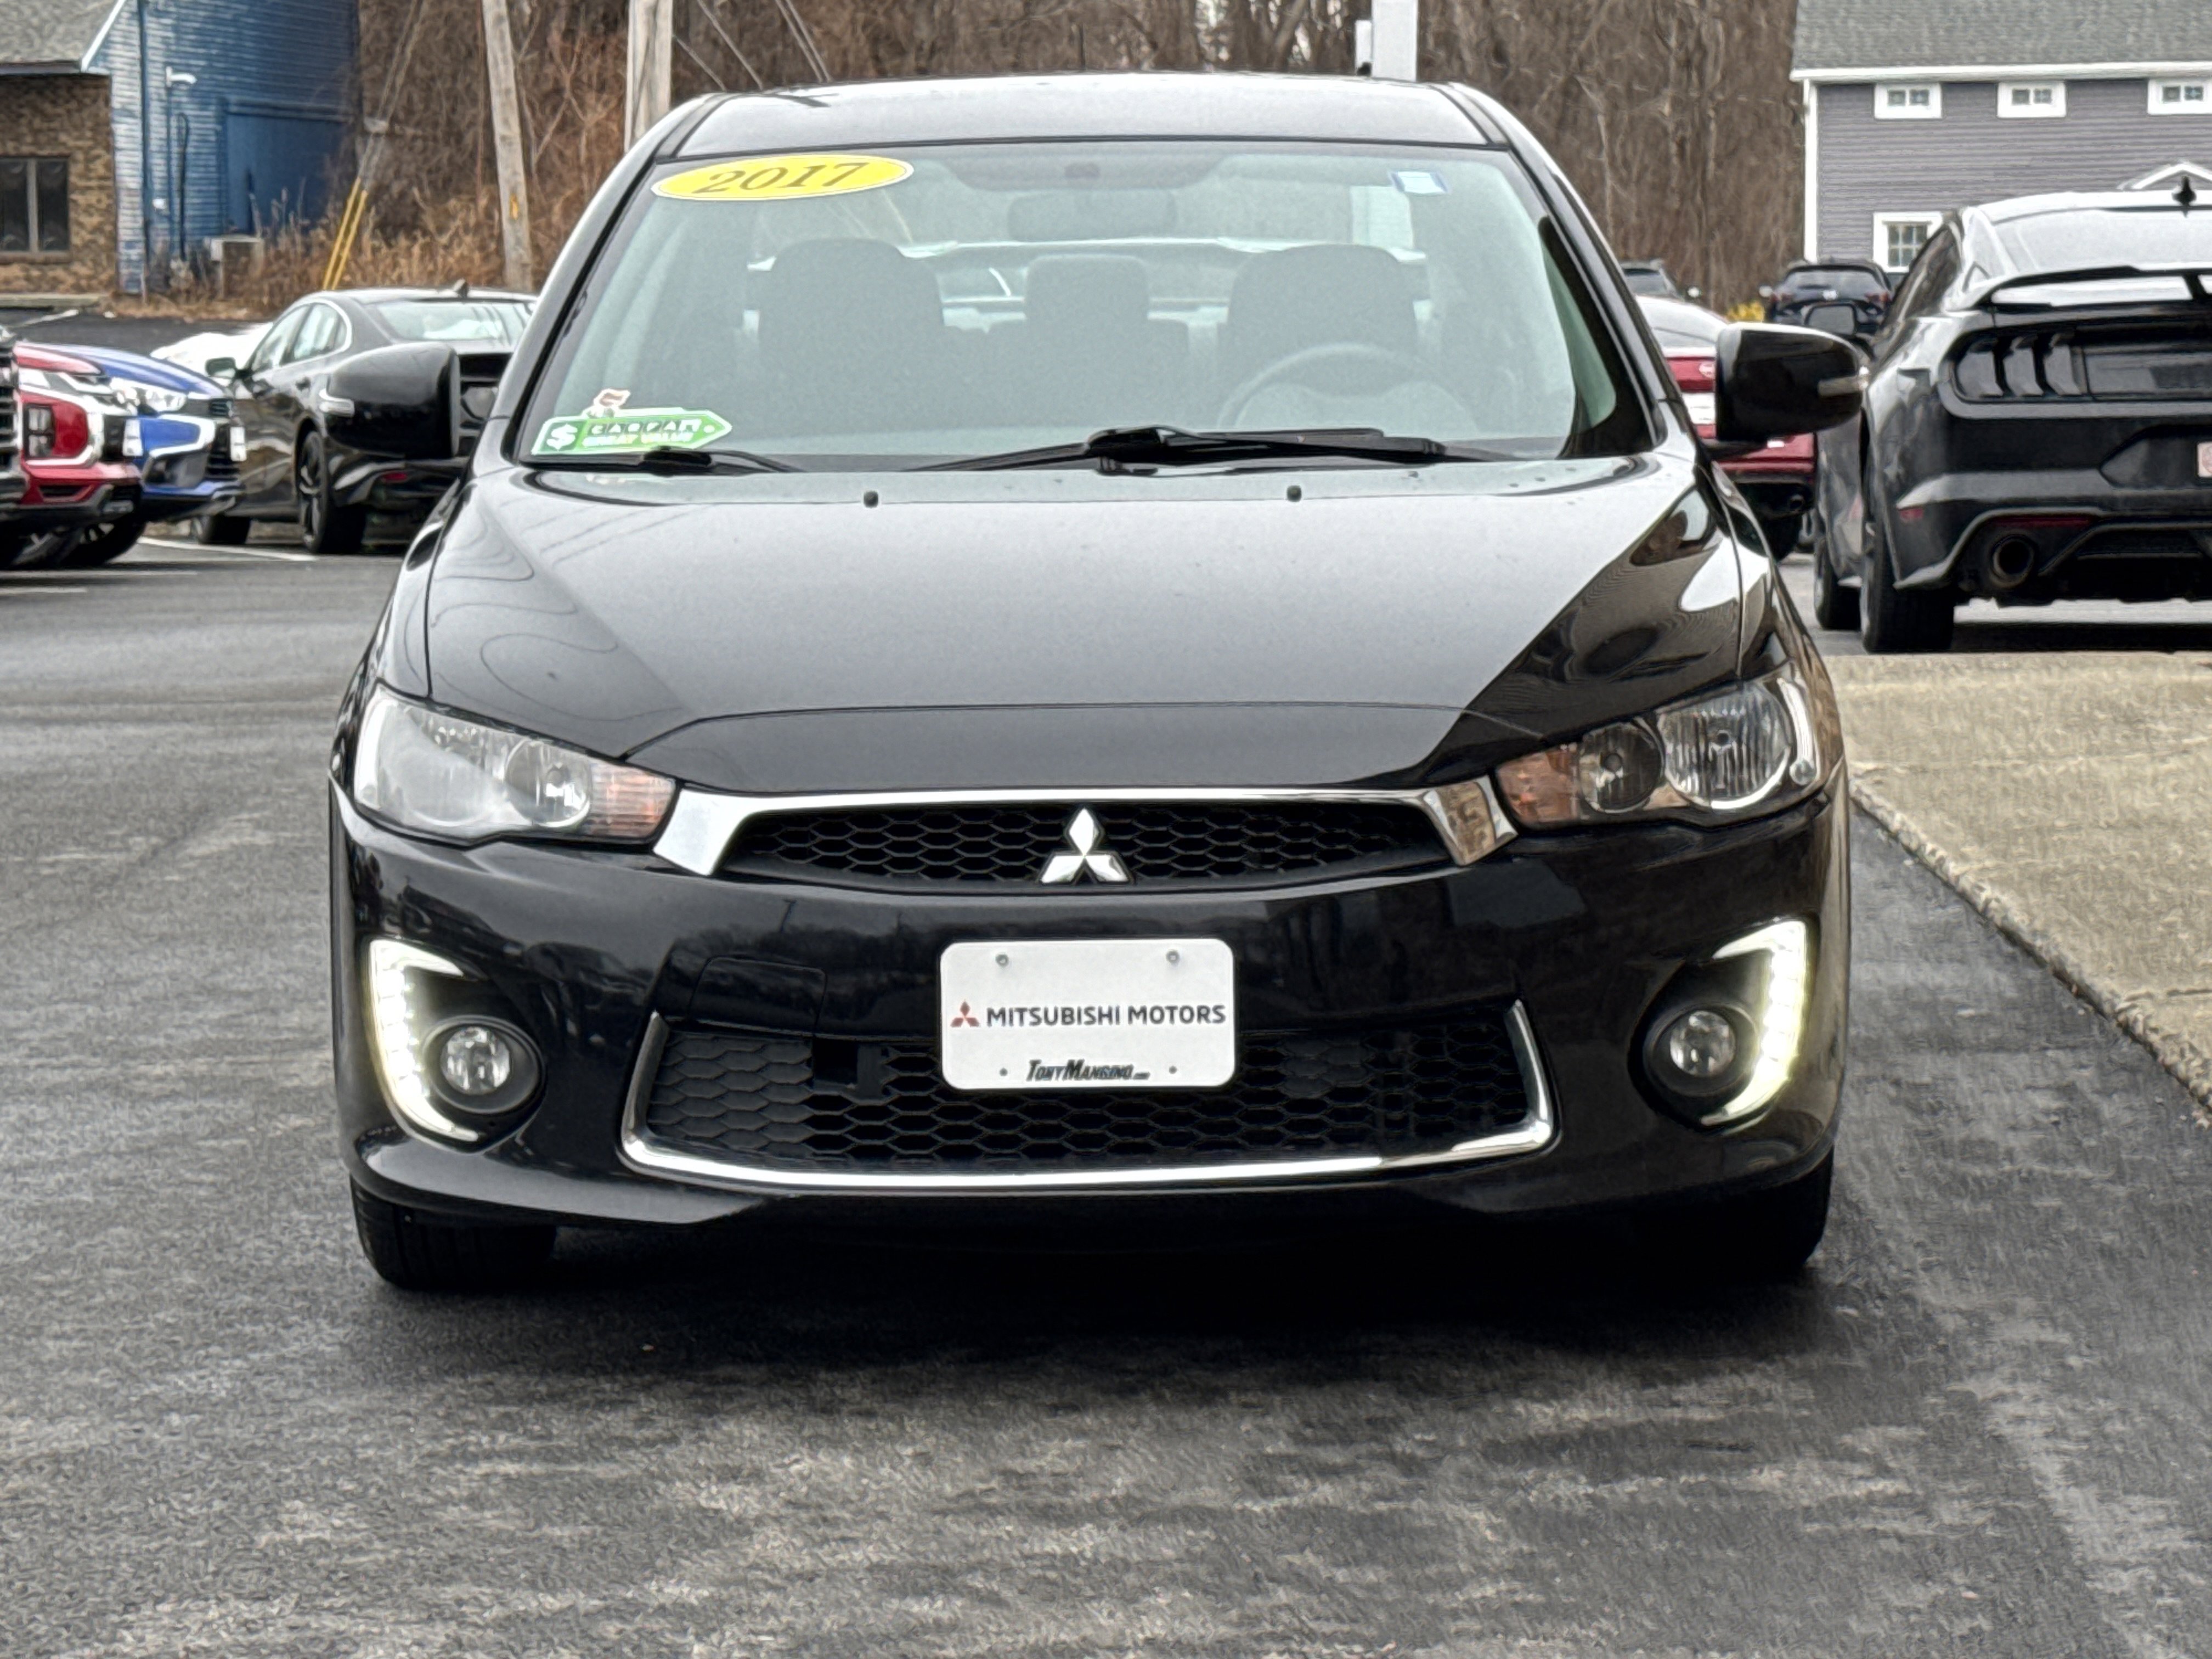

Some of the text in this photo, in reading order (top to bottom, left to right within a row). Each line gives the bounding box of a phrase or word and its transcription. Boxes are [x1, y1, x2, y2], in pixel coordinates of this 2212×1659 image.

[691, 162, 870, 194] 2017
[986, 1005, 1226, 1026] MITSUBISHI MOTORS
